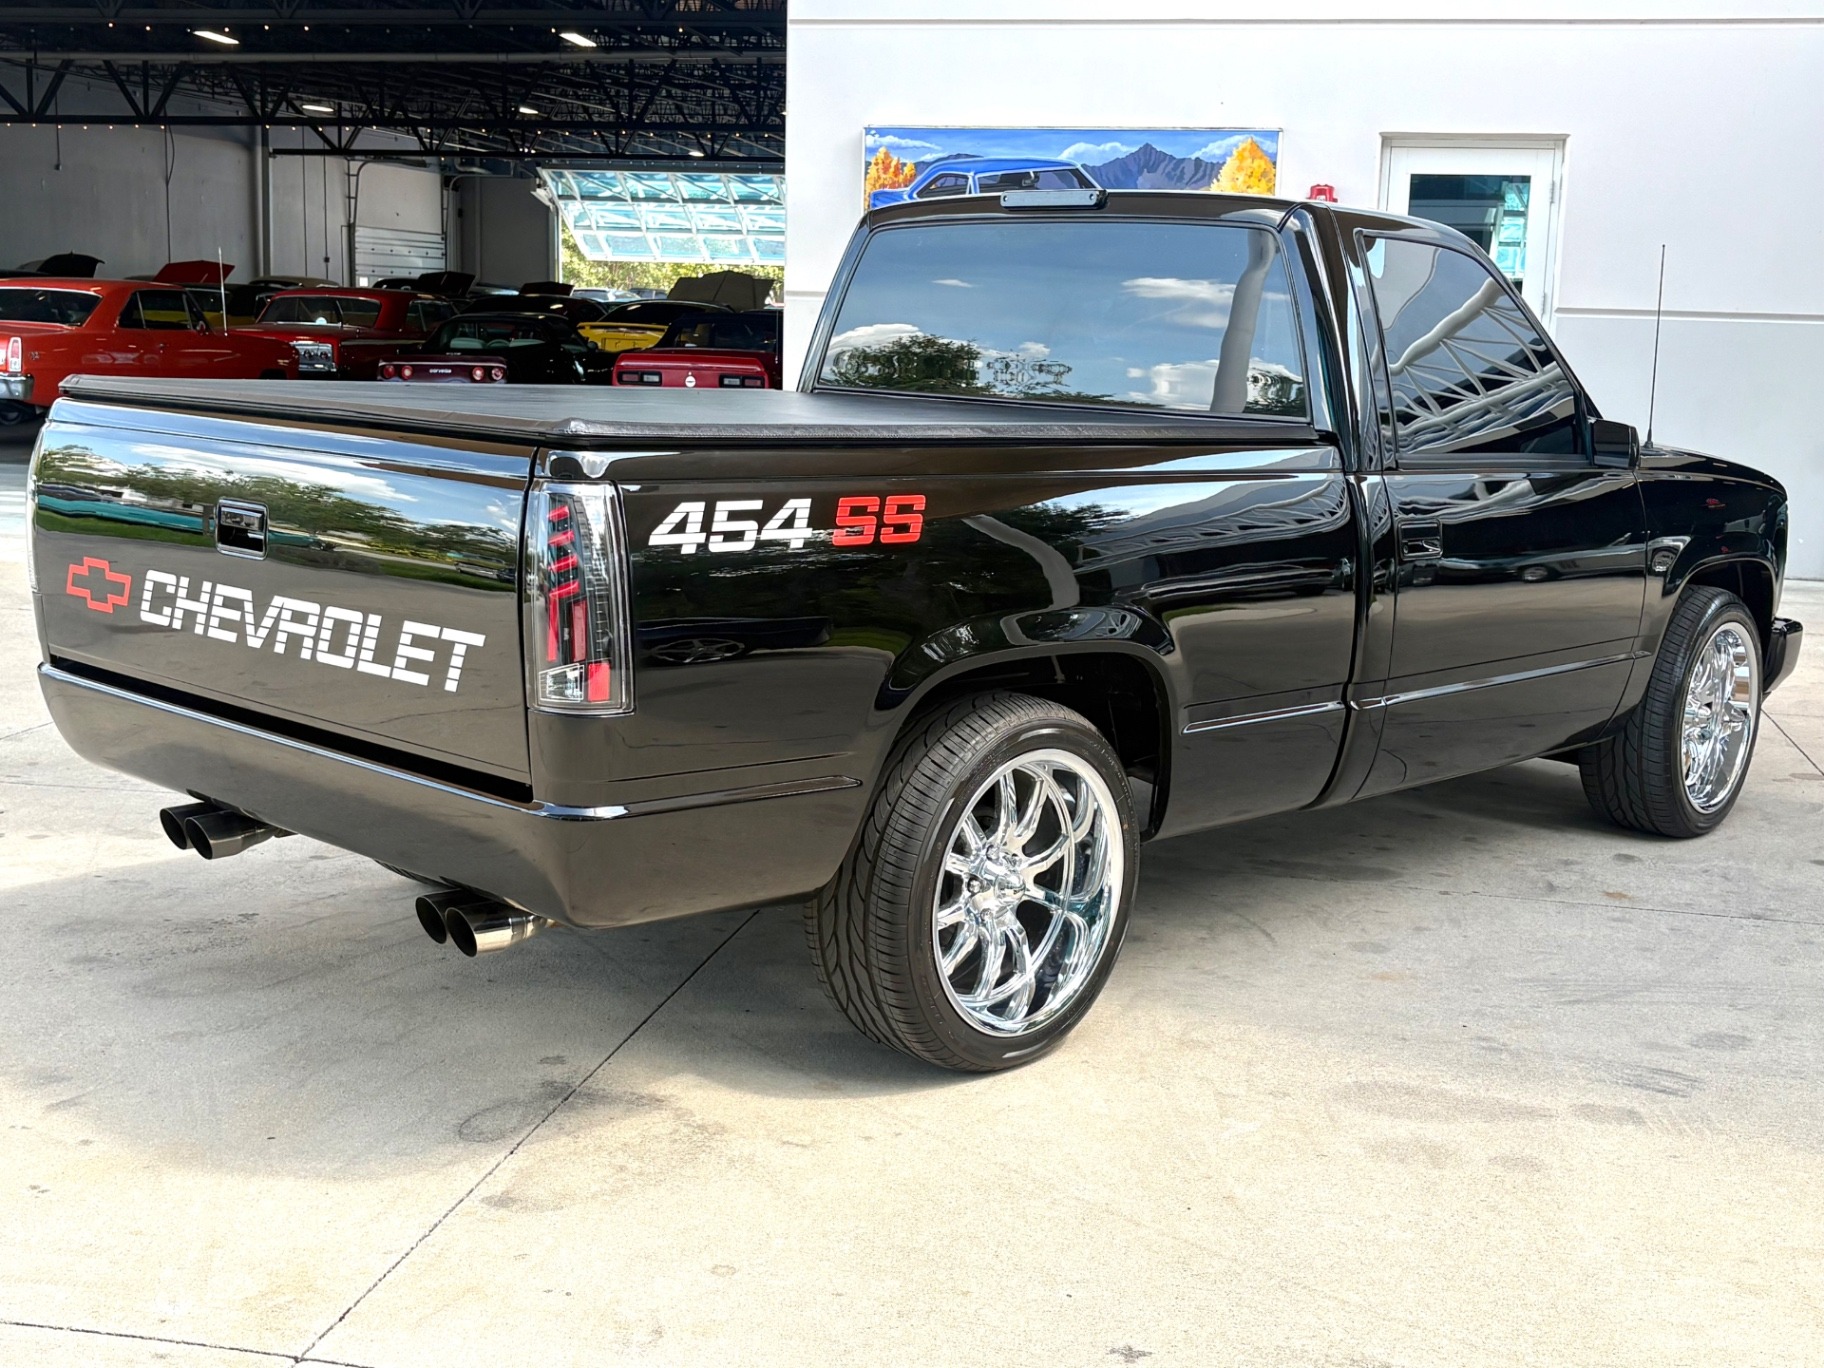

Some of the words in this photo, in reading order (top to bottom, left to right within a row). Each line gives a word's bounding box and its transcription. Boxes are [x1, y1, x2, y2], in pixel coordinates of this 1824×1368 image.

[648, 498, 812, 555] 454
[832, 494, 926, 547] SS
[140, 570, 486, 692] CHEVROLET
